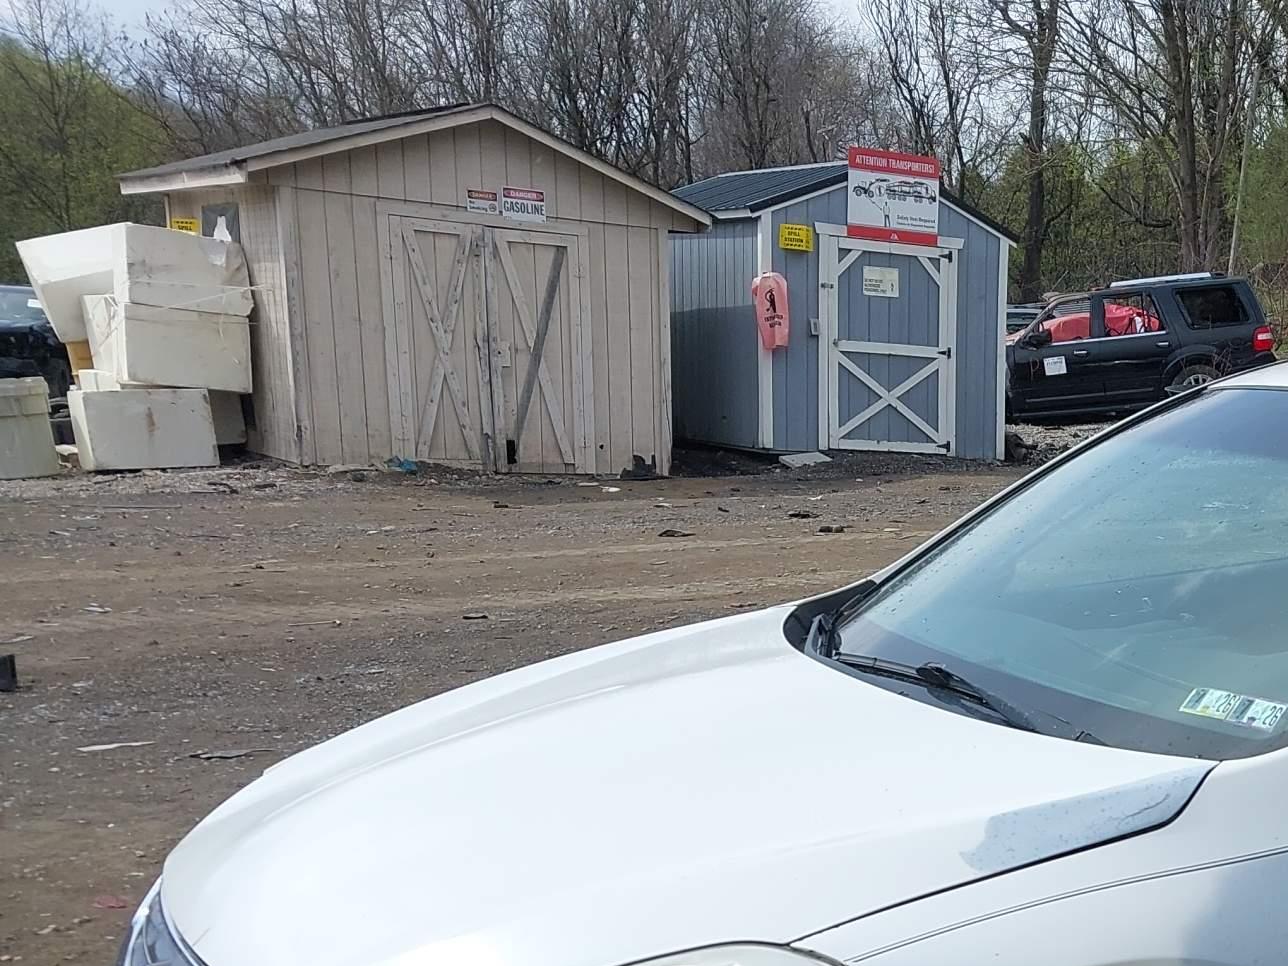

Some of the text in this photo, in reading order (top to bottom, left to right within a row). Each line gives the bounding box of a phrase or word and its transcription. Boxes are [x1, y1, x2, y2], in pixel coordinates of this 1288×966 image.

[855, 154, 935, 174] ATTENTION TRANSPORTERS!
[510, 190, 537, 200] DANGER
[504, 200, 545, 215] GASOLINE
[1216, 693, 1238, 713] 26
[1262, 705, 1284, 727] 26
